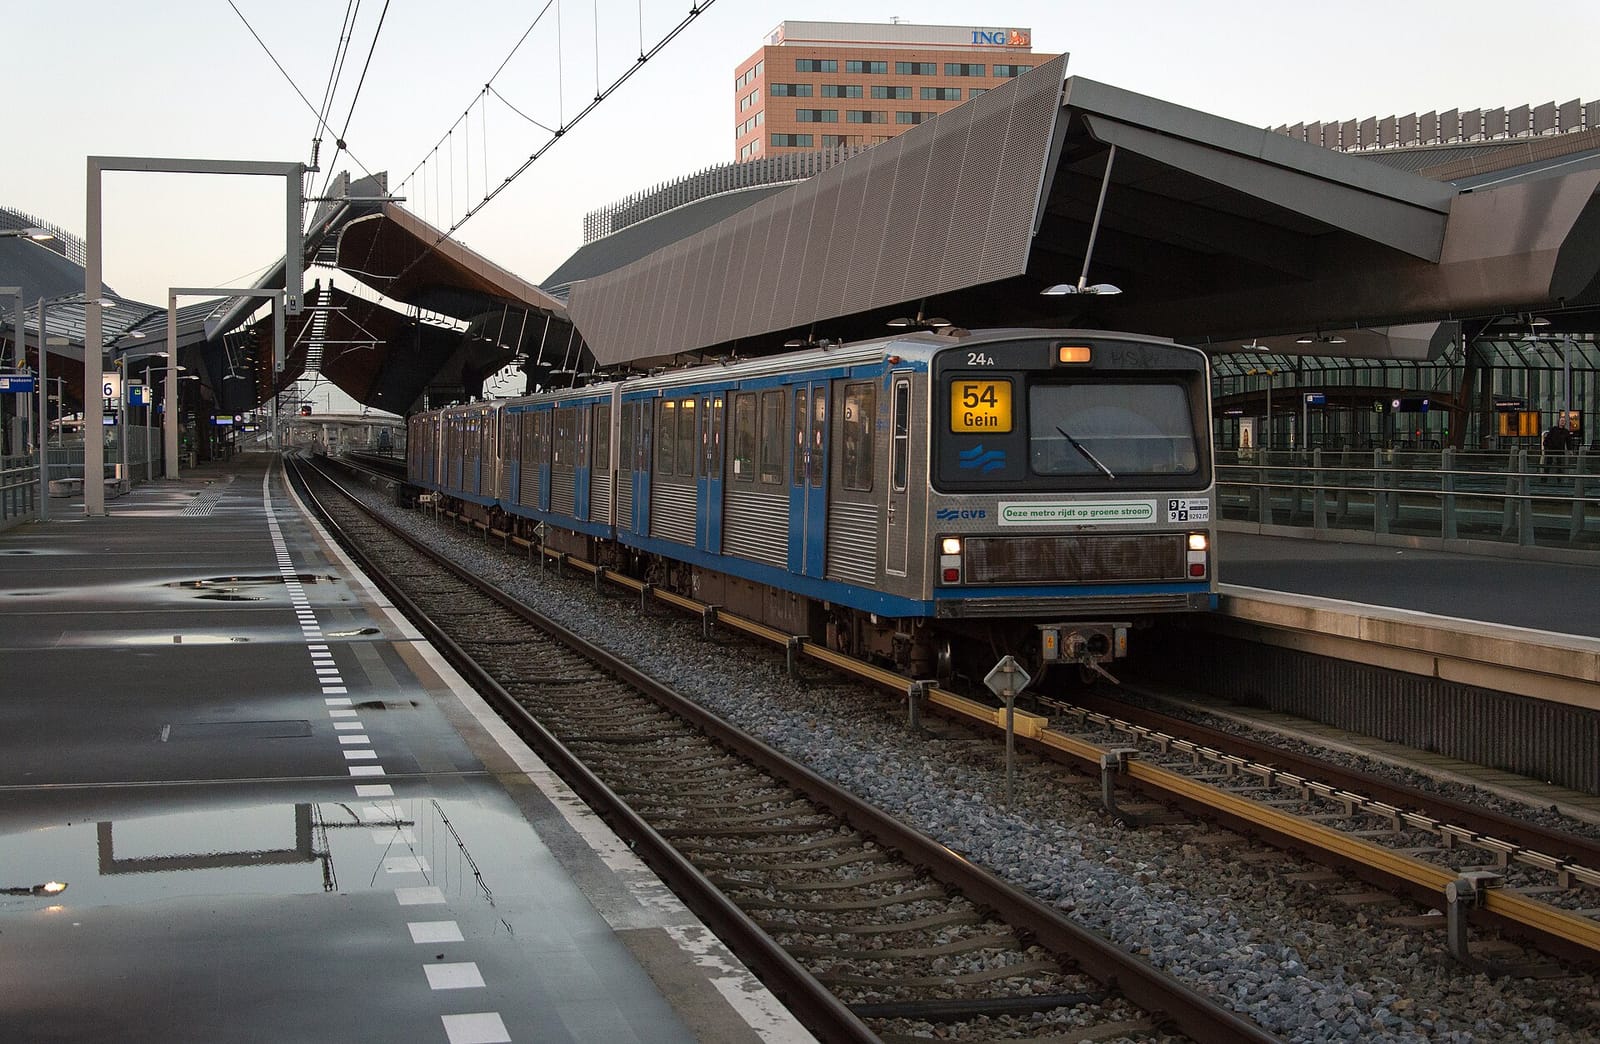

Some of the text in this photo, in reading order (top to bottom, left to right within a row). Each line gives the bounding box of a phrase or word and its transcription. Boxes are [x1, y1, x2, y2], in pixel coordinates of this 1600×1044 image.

[972, 31, 1006, 45] ING
[967, 352, 995, 366] 24A
[103, 382, 113, 396] 6
[963, 384, 998, 409] 54
[963, 411, 998, 427] Gein
[961, 510, 986, 519] GVB
[1006, 509, 1028, 517] Deze
[1030, 509, 1056, 517] metro
[1058, 508, 1076, 518] rijdt
[1077, 509, 1088, 517] op
[1090, 509, 1119, 517] groene
